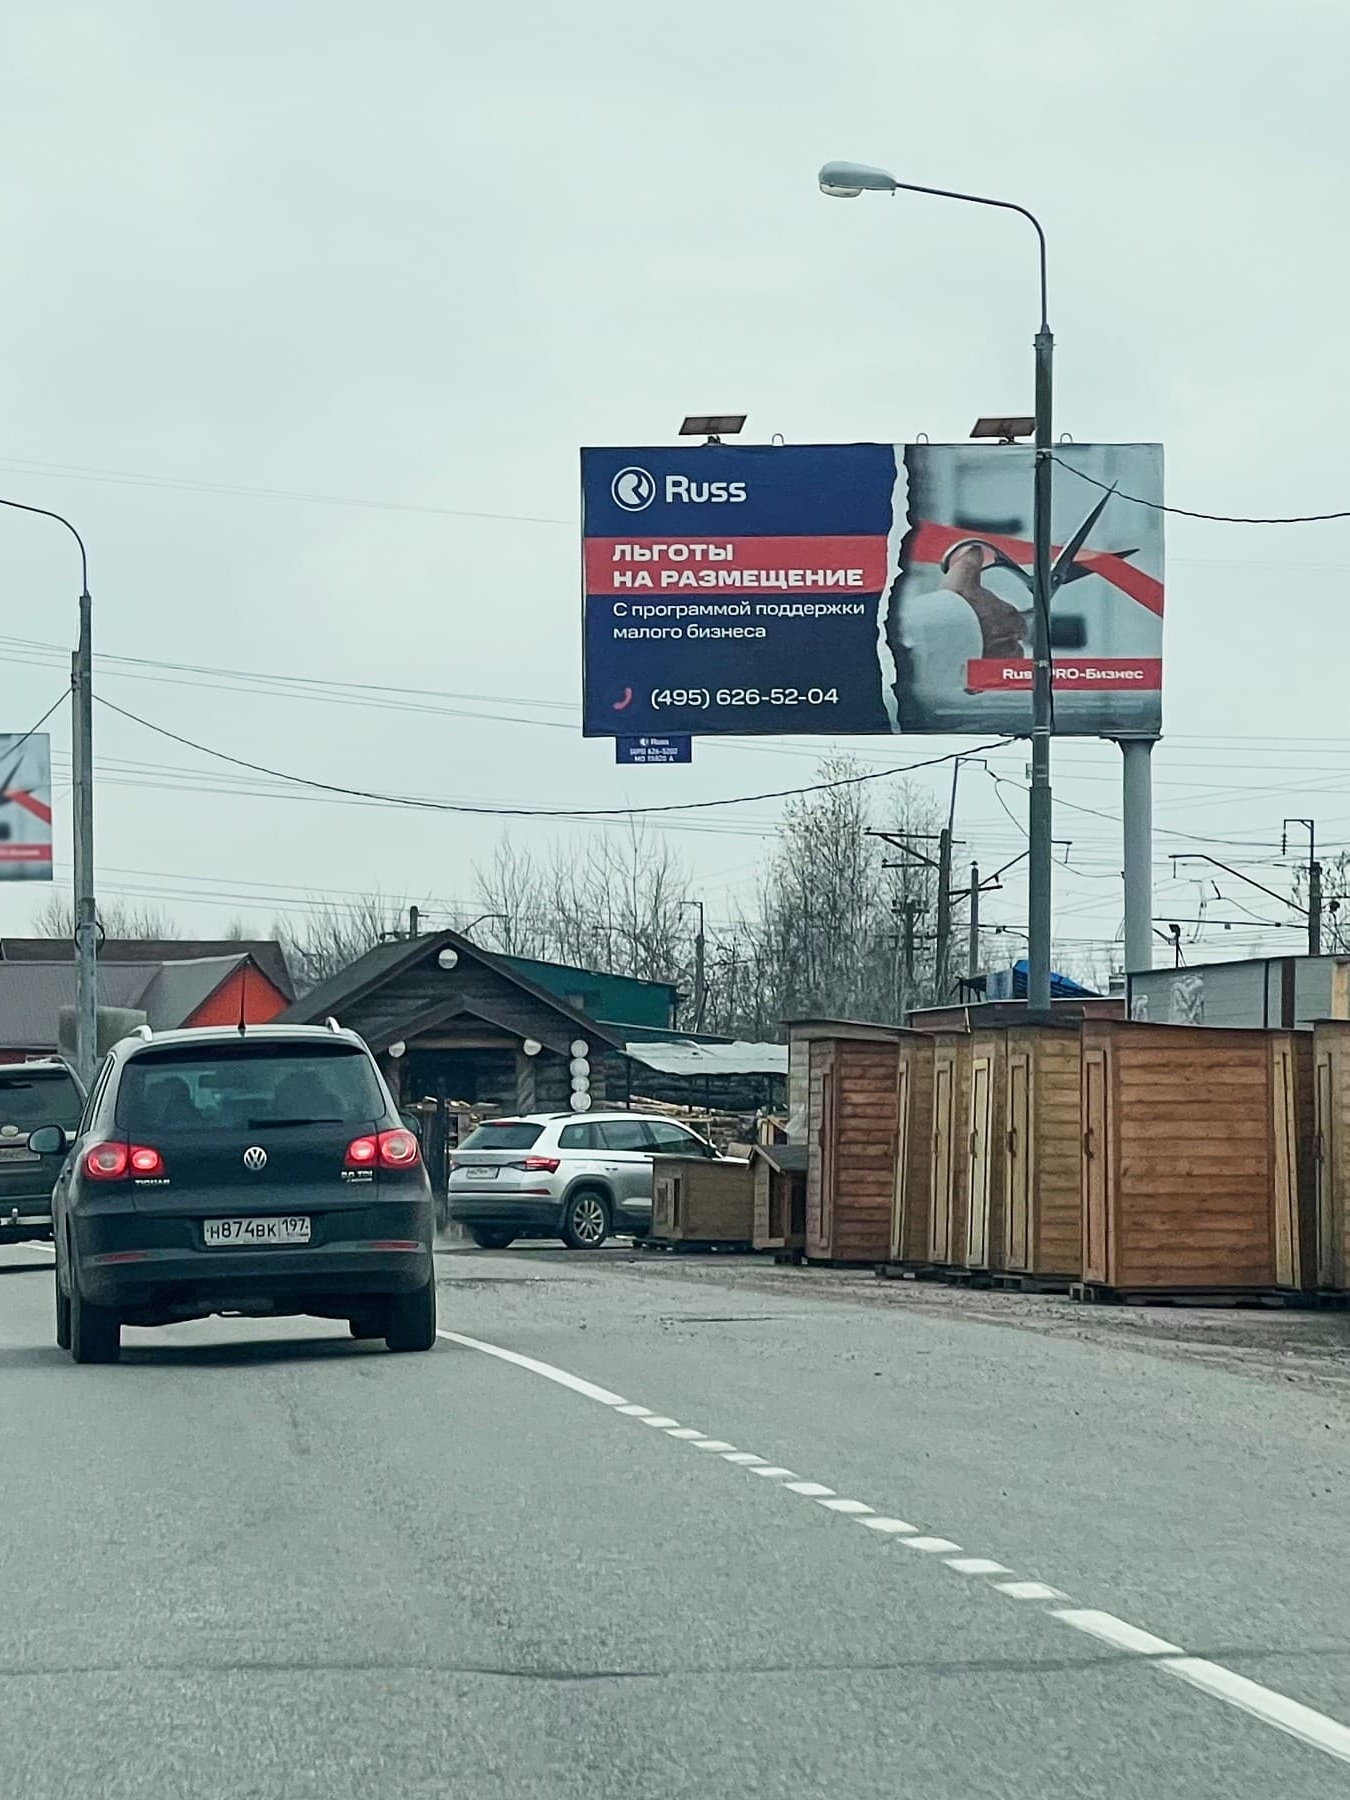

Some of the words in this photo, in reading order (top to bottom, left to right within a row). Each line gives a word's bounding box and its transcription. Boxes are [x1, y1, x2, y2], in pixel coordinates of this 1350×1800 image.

[665, 475, 747, 503] Russ
[612, 543, 733, 561] ЛЬГОТЫ
[613, 571, 653, 588] НА
[660, 569, 864, 589] РАЗМЕЩЕНИЕ
[613, 602, 628, 616] С
[631, 601, 751, 619] программой
[756, 602, 865, 618] поддержки
[613, 626, 682, 639] малого
[686, 623, 766, 638] бизнеса
[1003, 668, 1033, 680] Rus
[1051, 668, 1144, 680] RO-Бизнес
[651, 688, 710, 709] (495)
[716, 688, 839, 705] 626-52-04
